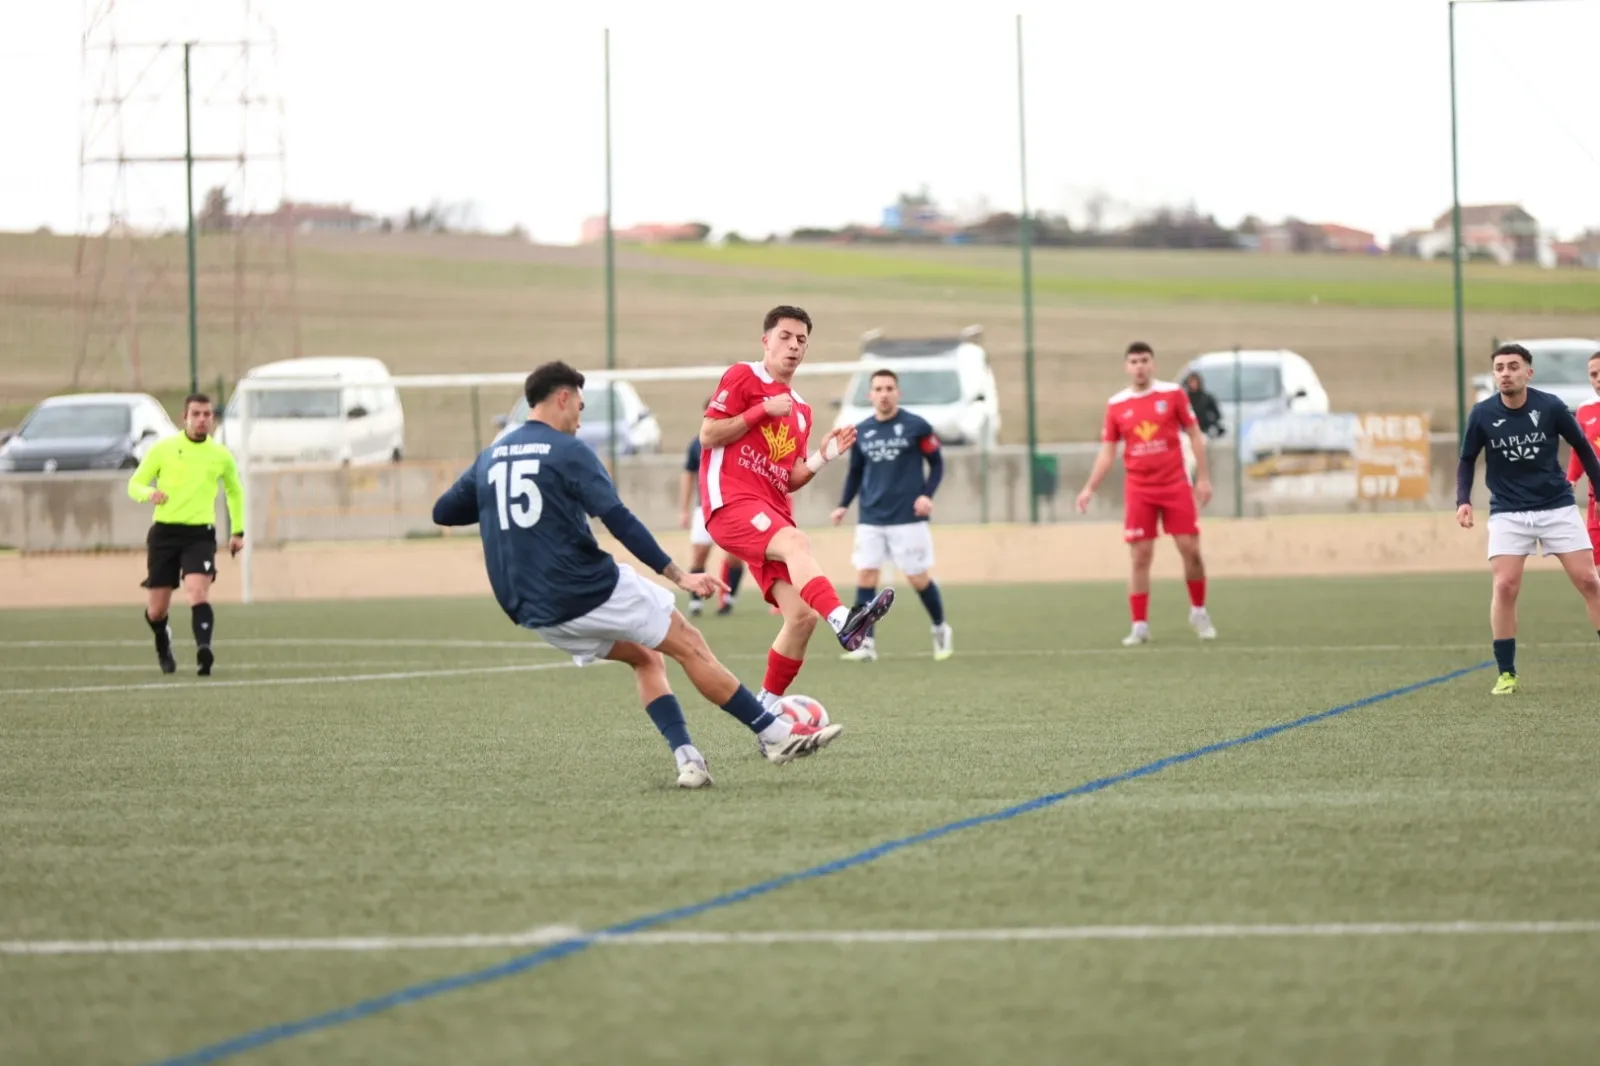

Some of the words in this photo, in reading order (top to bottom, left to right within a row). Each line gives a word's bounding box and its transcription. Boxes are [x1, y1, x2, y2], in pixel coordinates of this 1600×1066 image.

[1491, 438, 1508, 449] LA
[1508, 432, 1547, 447] PLAZA
[738, 457, 751, 469] DE
[740, 444, 767, 467] CAJA
[487, 459, 543, 530] 15
